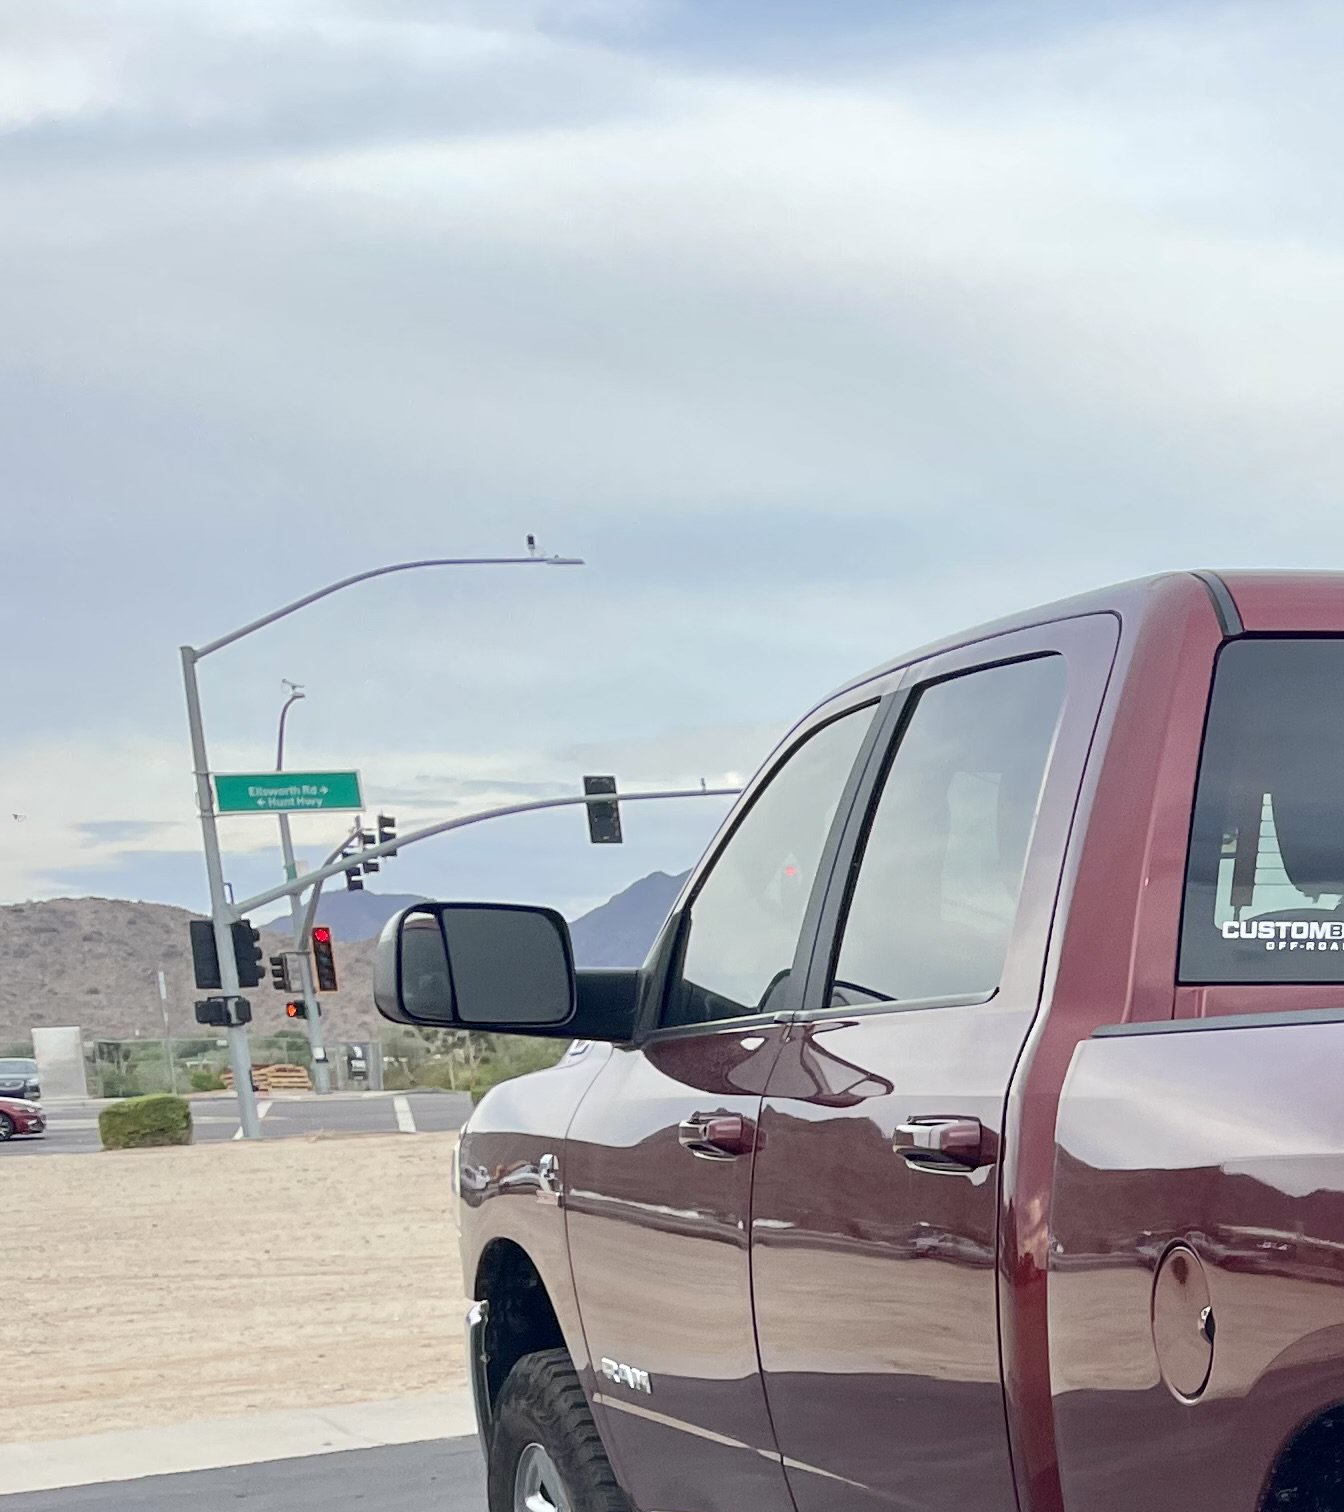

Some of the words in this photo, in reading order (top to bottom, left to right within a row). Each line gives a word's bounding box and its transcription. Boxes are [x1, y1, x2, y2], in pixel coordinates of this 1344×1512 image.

[248, 786, 300, 797] Ellsworth
[302, 785, 317, 796] Rd
[268, 797, 295, 807] Hunt
[297, 797, 323, 808] Hwy
[601, 1357, 651, 1394] RAM
